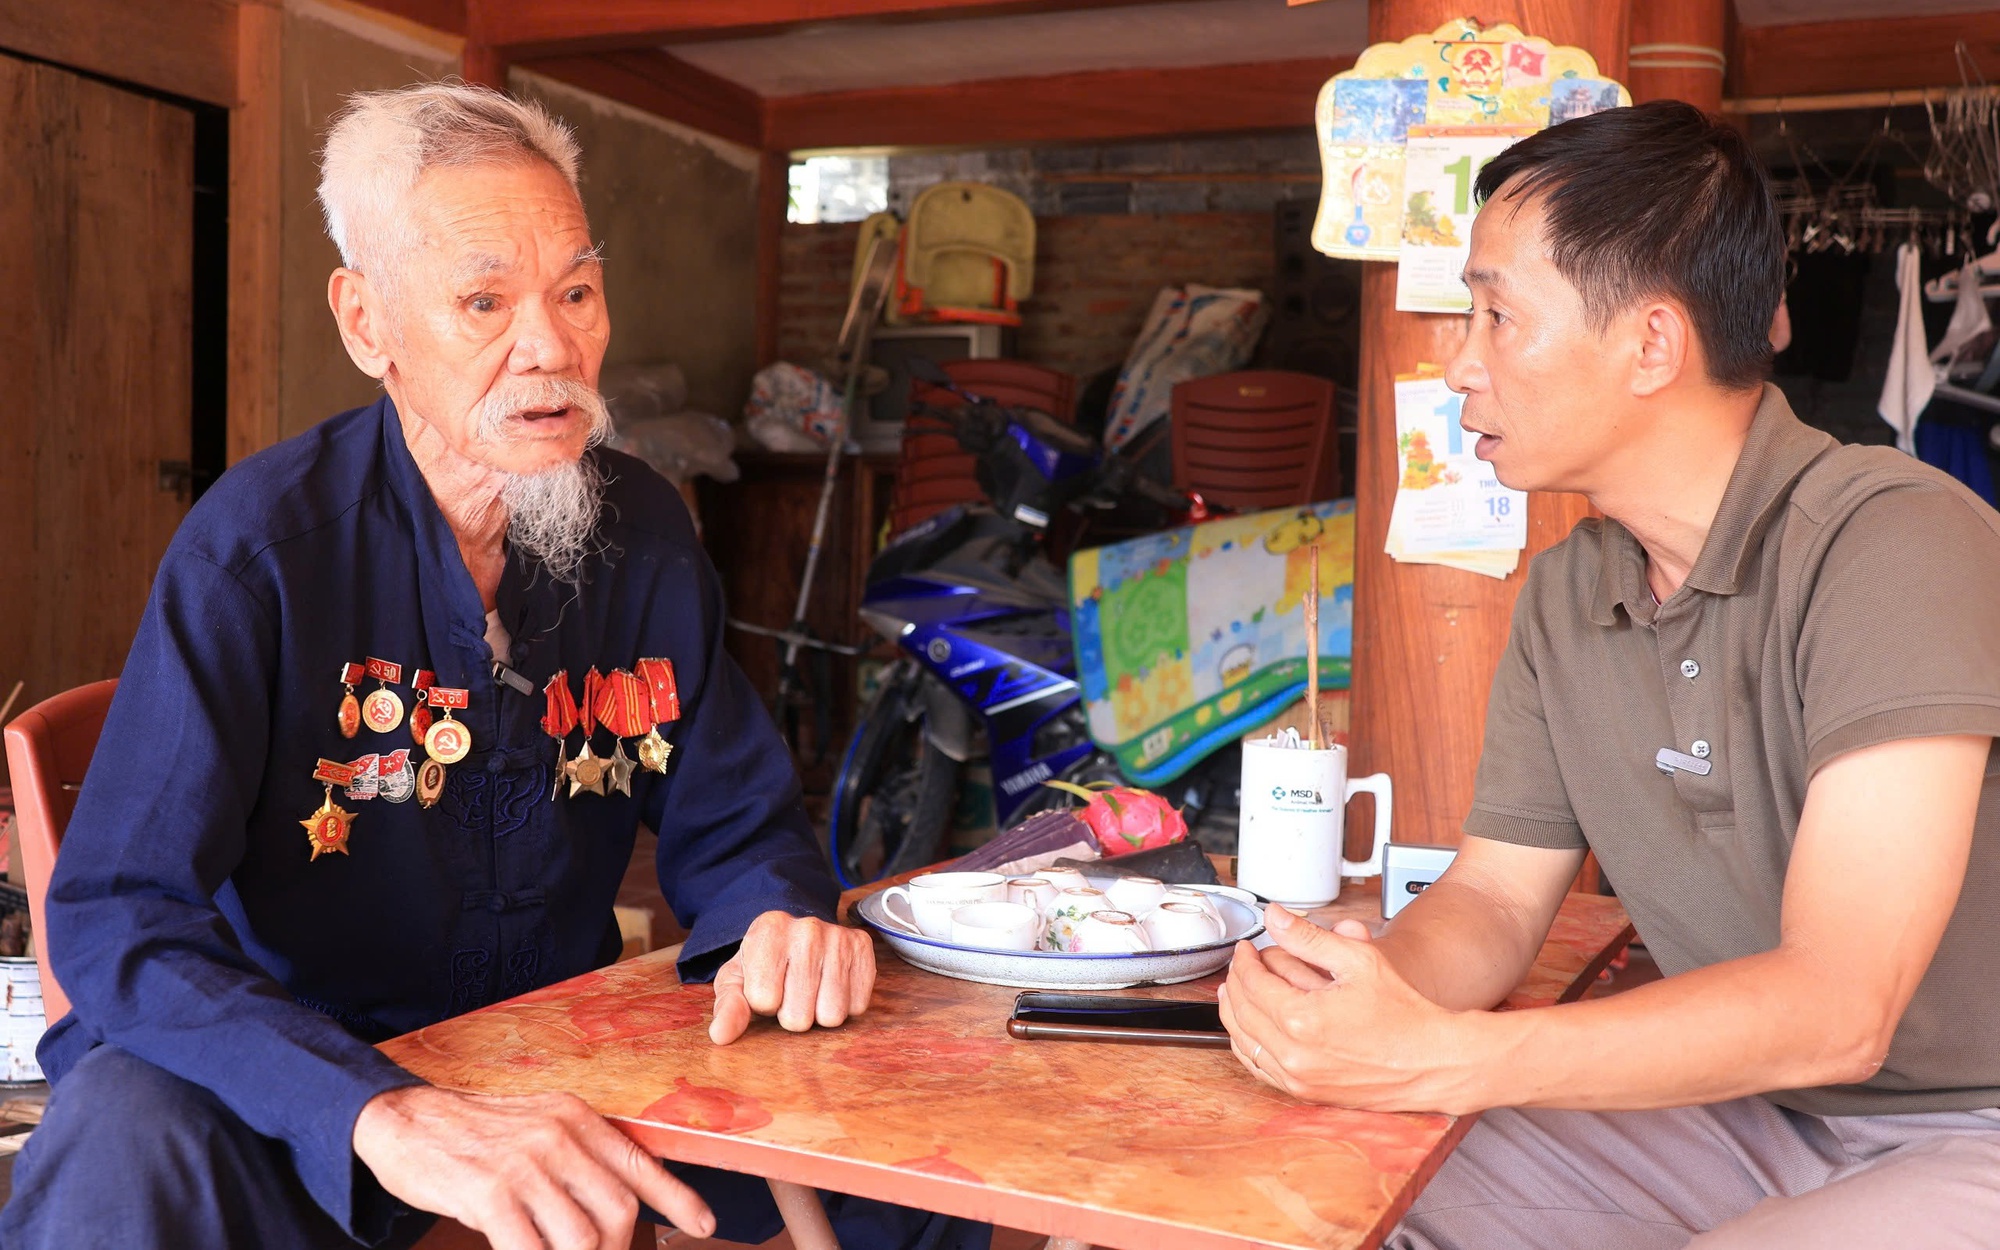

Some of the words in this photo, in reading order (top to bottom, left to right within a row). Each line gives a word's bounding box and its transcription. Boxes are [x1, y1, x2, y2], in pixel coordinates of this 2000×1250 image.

[1485, 496, 1510, 516] 18
[383, 665, 397, 680] 50
[448, 692, 463, 704] 60
[1290, 789, 1313, 798] MSD
